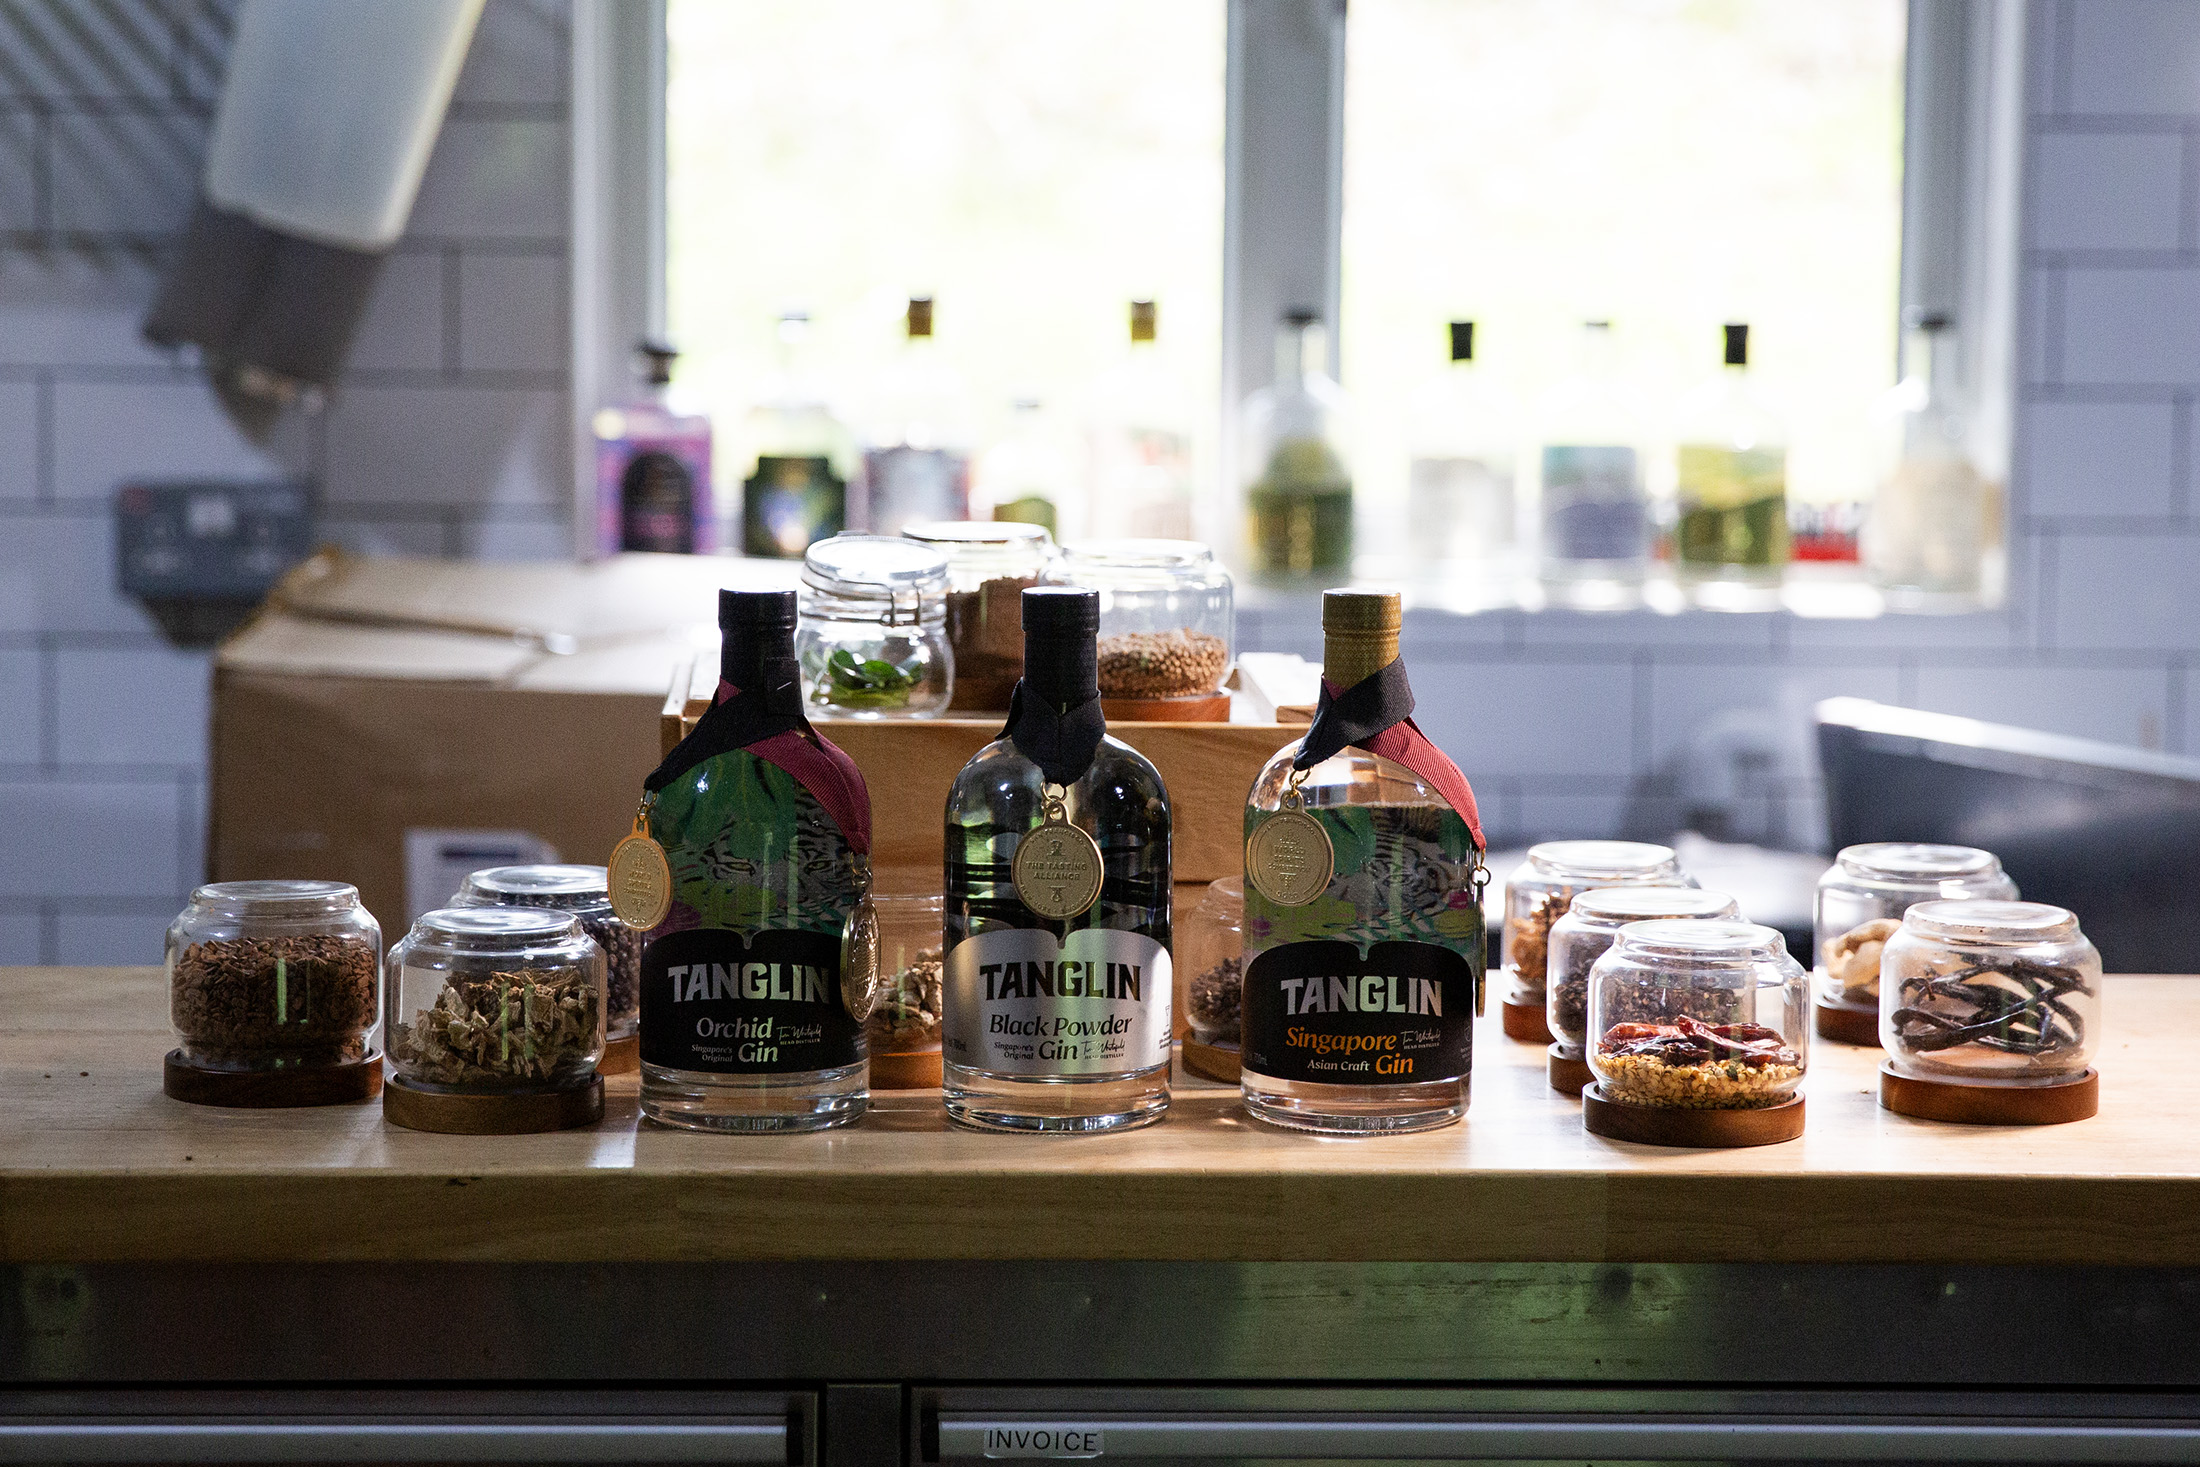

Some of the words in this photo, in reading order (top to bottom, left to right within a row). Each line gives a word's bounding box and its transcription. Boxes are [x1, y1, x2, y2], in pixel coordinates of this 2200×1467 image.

[1026, 861, 1044, 870] THE
[1047, 861, 1087, 871] TASTING
[1033, 872, 1080, 881] ALLIANCE
[667, 962, 831, 1004] TANGLIN
[980, 961, 1141, 1002] TANGLIN
[1280, 975, 1443, 1017] TANGLIN
[696, 1016, 774, 1038] Orchid
[989, 1014, 1050, 1037] Black
[1053, 1014, 1133, 1037] Powder
[691, 1043, 733, 1055] Singapore's
[994, 1041, 1034, 1052] Singapore's
[1038, 1040, 1078, 1061] Gin
[1285, 1026, 1398, 1055] Singapore
[702, 1054, 733, 1063] Original
[738, 1041, 778, 1063] Gin
[1004, 1051, 1034, 1061] Original
[1307, 1059, 1338, 1071] Asian
[1340, 1059, 1370, 1071] Craft
[1375, 1053, 1414, 1075] Gin
[988, 1429, 1098, 1451] INVOICE
